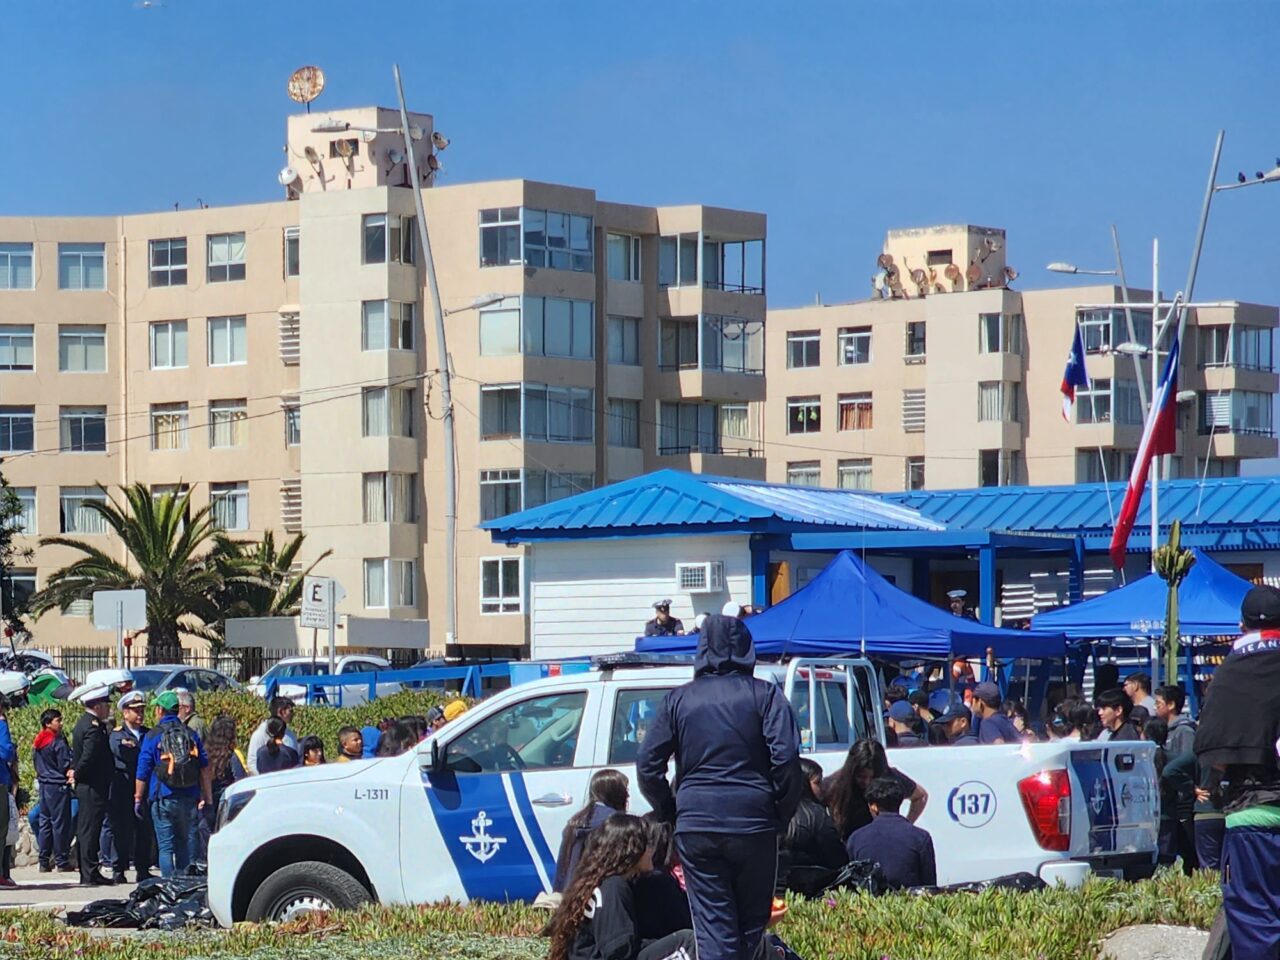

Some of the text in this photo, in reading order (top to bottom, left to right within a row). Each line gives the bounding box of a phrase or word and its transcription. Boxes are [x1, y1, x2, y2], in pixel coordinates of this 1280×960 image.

[312, 584, 323, 602] E
[354, 788, 389, 800] L-1311
[956, 793, 990, 815] 137
